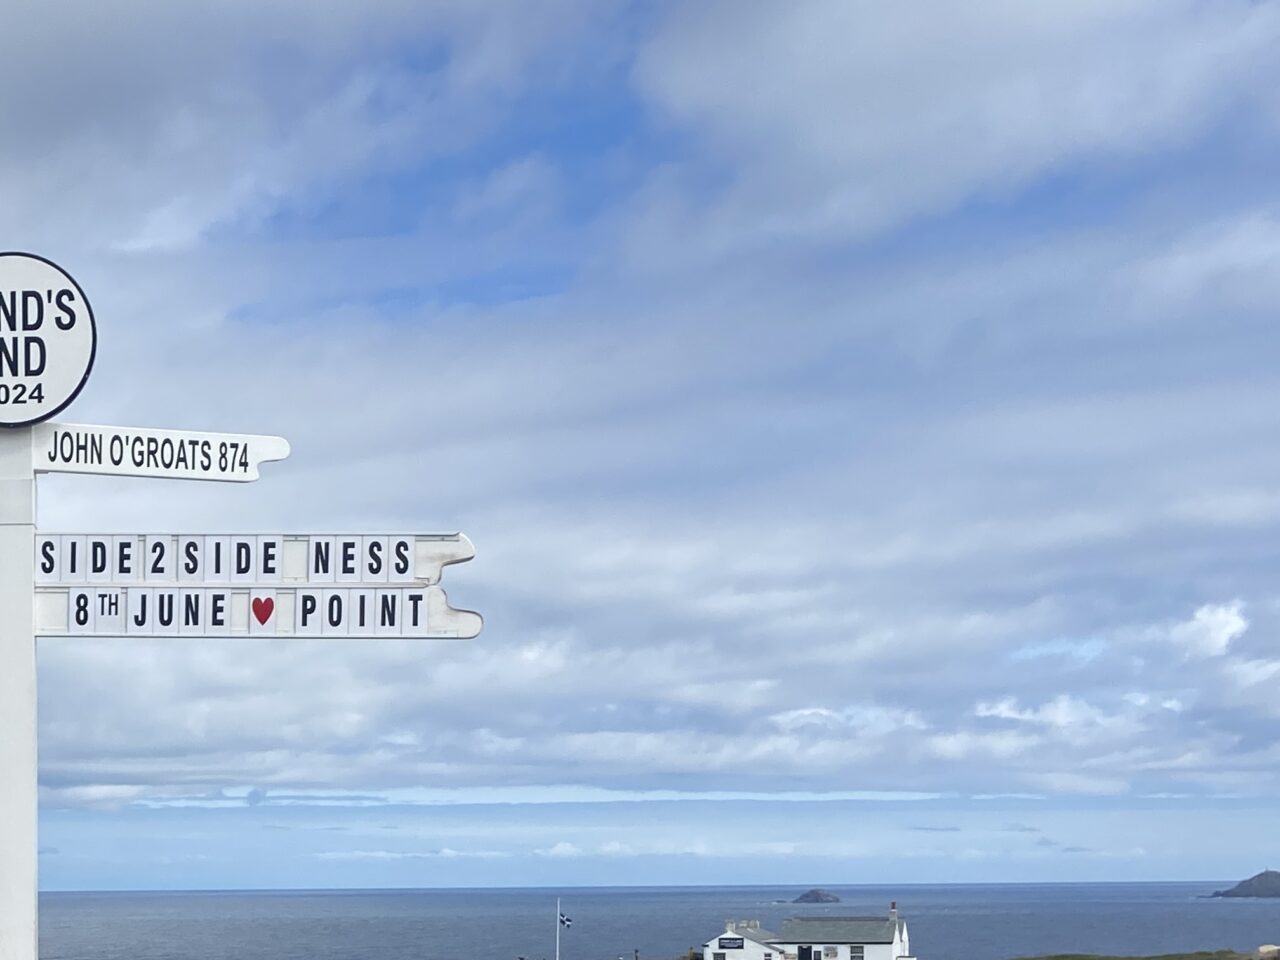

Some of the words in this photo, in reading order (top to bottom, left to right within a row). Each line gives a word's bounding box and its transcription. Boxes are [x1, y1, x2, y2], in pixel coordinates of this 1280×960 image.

[47, 431, 103, 465] JOHN
[110, 435, 212, 472] O'GROATS
[218, 442, 249, 473] 874
[314, 540, 410, 575] NESS
[133, 593, 225, 627] JUNE
[301, 594, 423, 628] POINT
